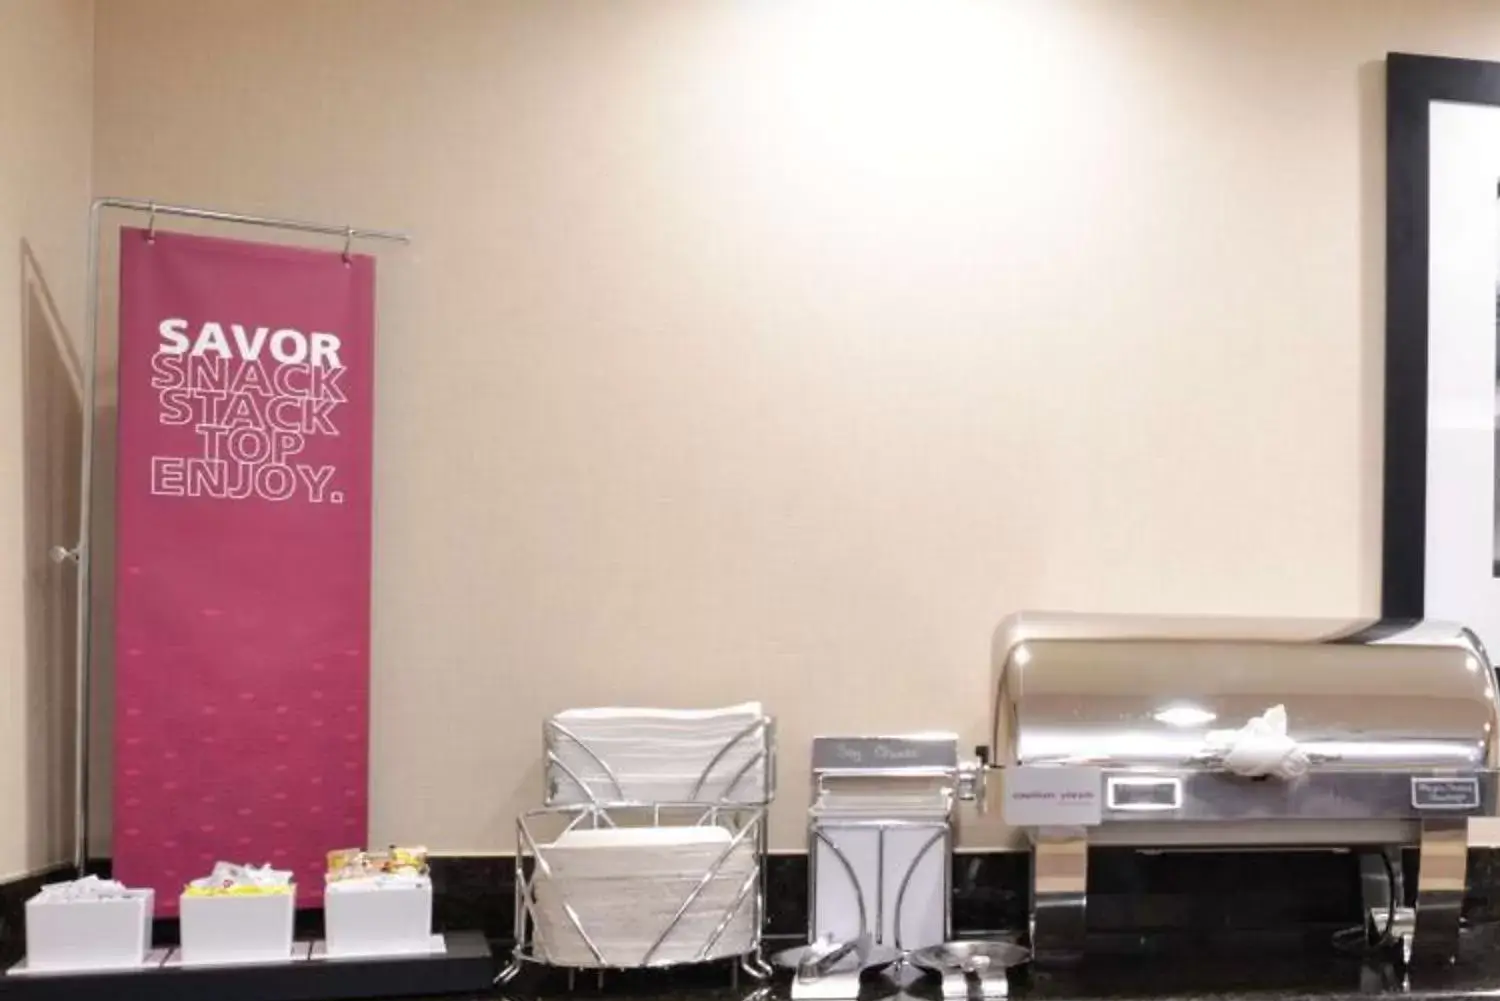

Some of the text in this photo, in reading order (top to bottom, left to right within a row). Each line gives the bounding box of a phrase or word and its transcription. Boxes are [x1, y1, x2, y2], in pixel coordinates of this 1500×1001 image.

[158, 319, 341, 369] SAVOR
[151, 352, 348, 402] SNACK
[160, 387, 339, 435] STACK
[196, 424, 305, 466] TOP
[150, 457, 344, 503] ENJOY.
